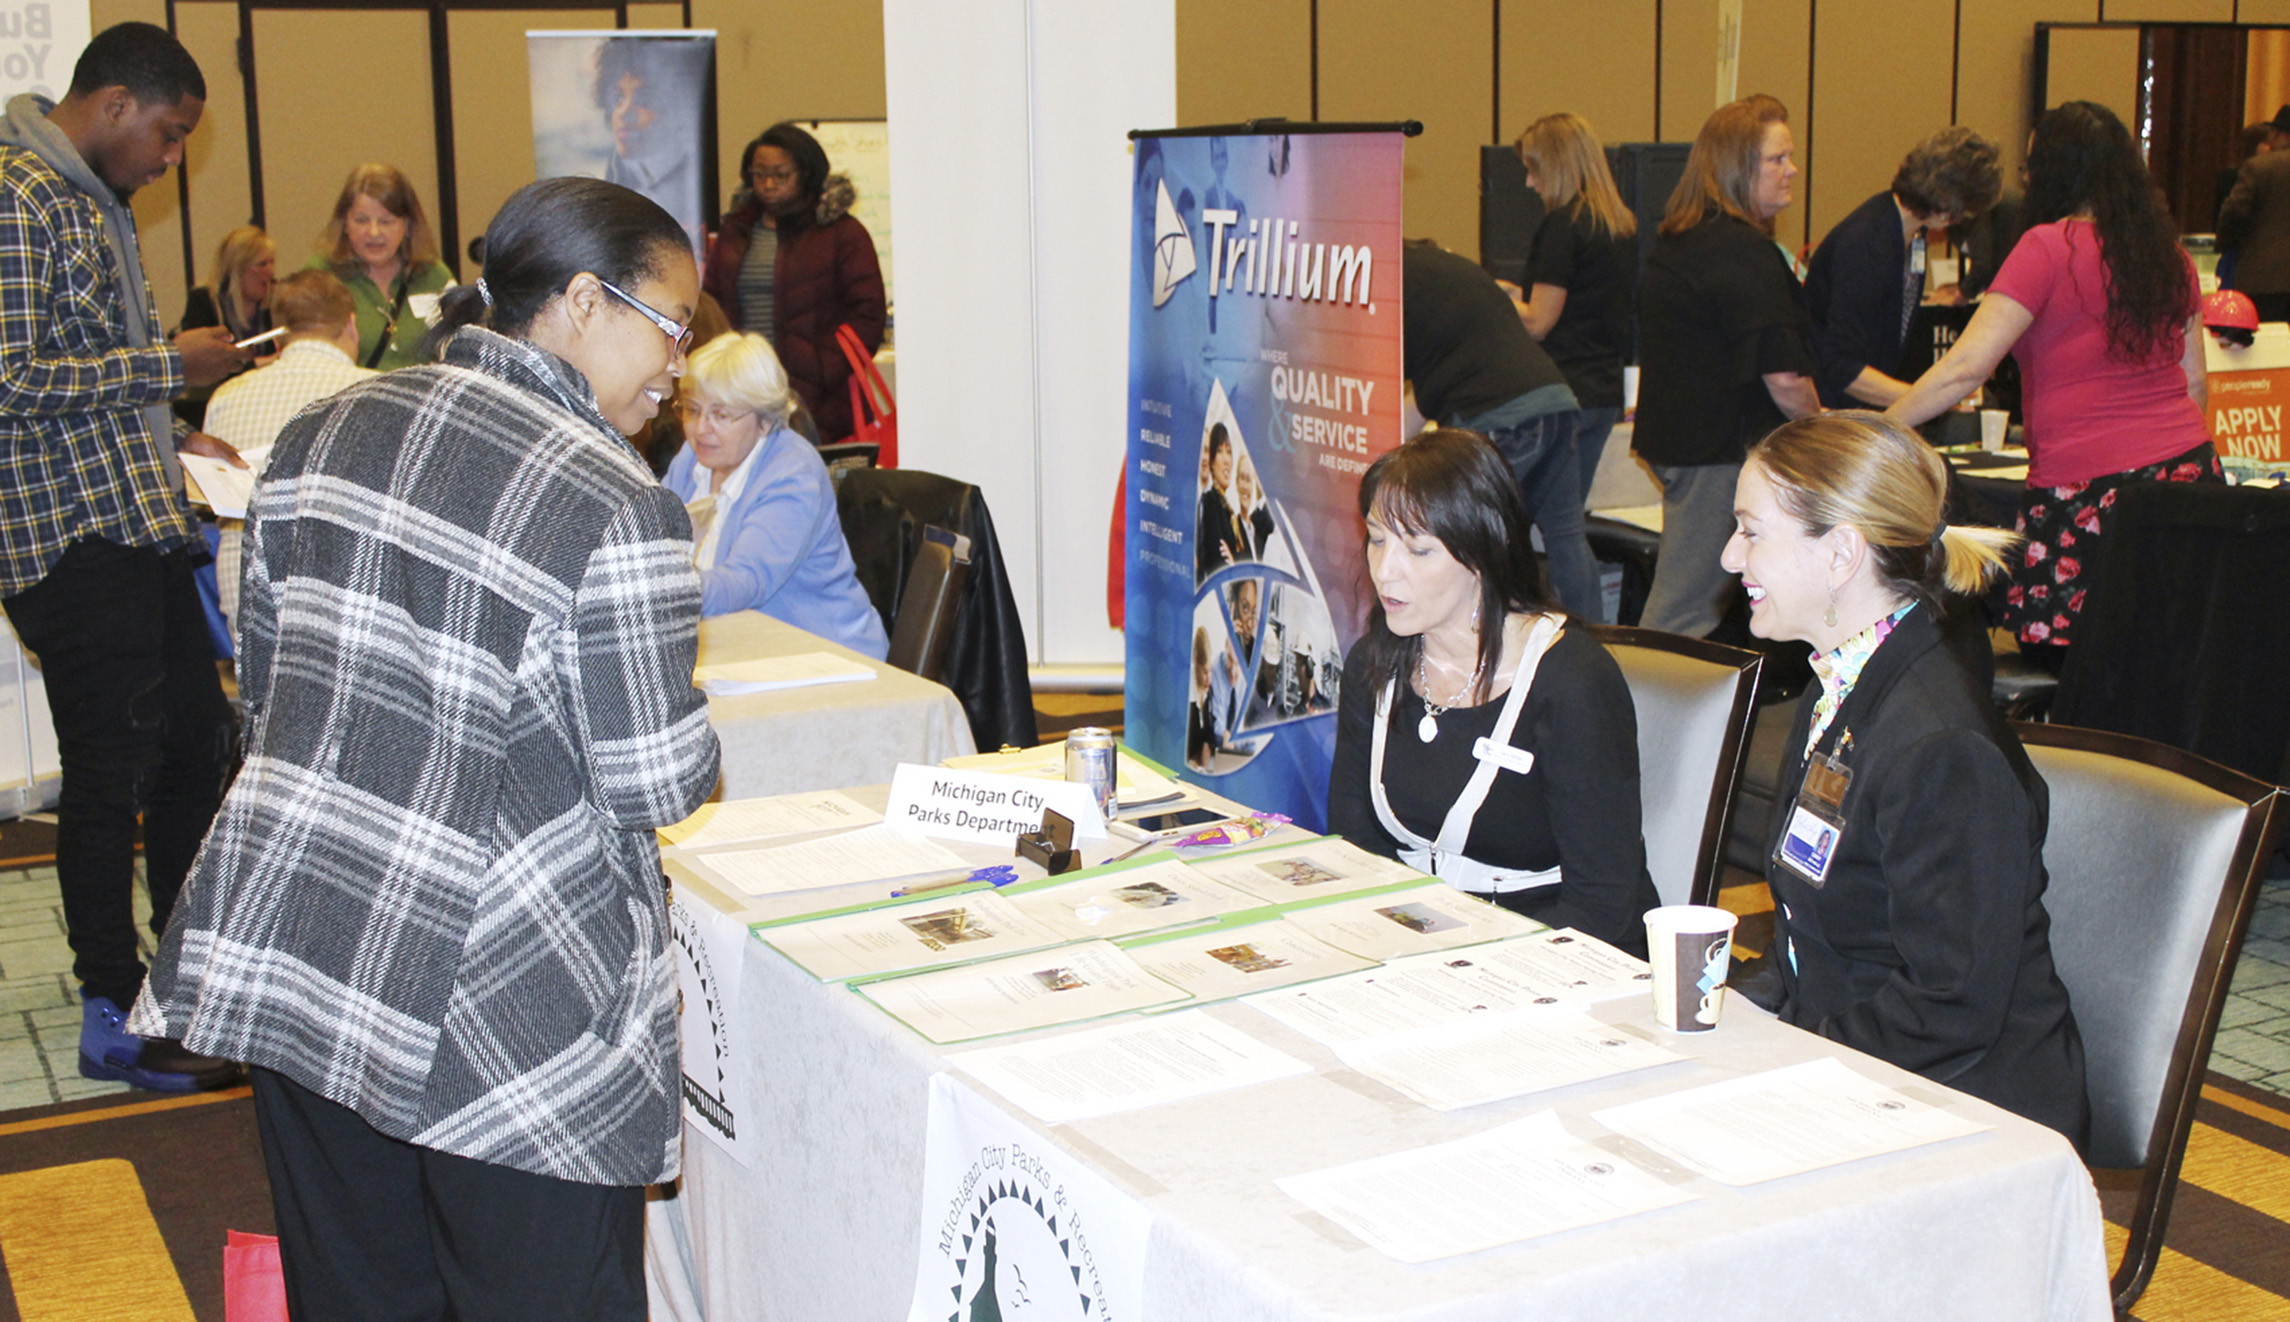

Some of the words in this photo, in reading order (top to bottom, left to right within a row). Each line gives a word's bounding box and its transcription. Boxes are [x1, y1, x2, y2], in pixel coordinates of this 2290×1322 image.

[1260, 348, 1289, 365] WHERE
[1271, 365, 1374, 416] QUALITY
[1292, 413, 1368, 455] SERVICE
[2215, 405, 2281, 436] APPLY
[1140, 428, 1171, 449] RELIABLE
[2226, 433, 2281, 460] NOW
[1140, 459, 1166, 478] HONEST
[1319, 453, 1336, 470] ARE
[1139, 519, 1183, 545] INTELLIGENT
[931, 780, 1007, 807] Michigan
[1011, 789, 1045, 813] City
[908, 803, 951, 826] Parks
[698, 936, 730, 1058] Recreation
[938, 1161, 982, 1259] Michigan
[981, 1144, 1006, 1171] City
[1011, 1142, 1052, 1190] Parks
[1054, 1184, 1068, 1212] &
